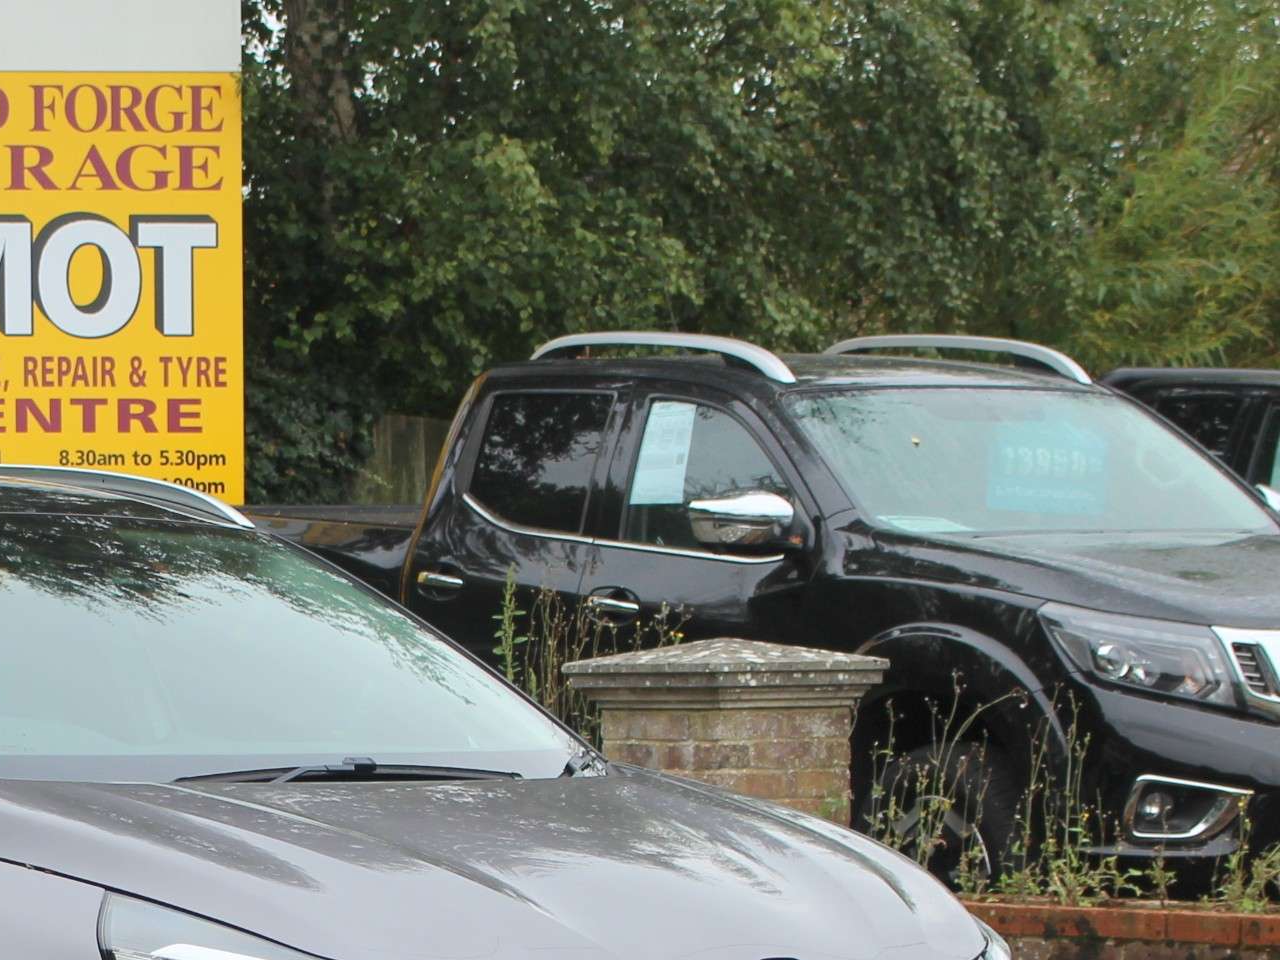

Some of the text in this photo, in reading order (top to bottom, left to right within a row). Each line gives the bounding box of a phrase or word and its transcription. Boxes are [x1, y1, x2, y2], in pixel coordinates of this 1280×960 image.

[28, 83, 225, 133] FORGE
[23, 355, 117, 388] REPAIR
[129, 355, 147, 388] &
[159, 356, 228, 388] TYRE
[59, 450, 226, 471] 8.30am to 5.30pm
